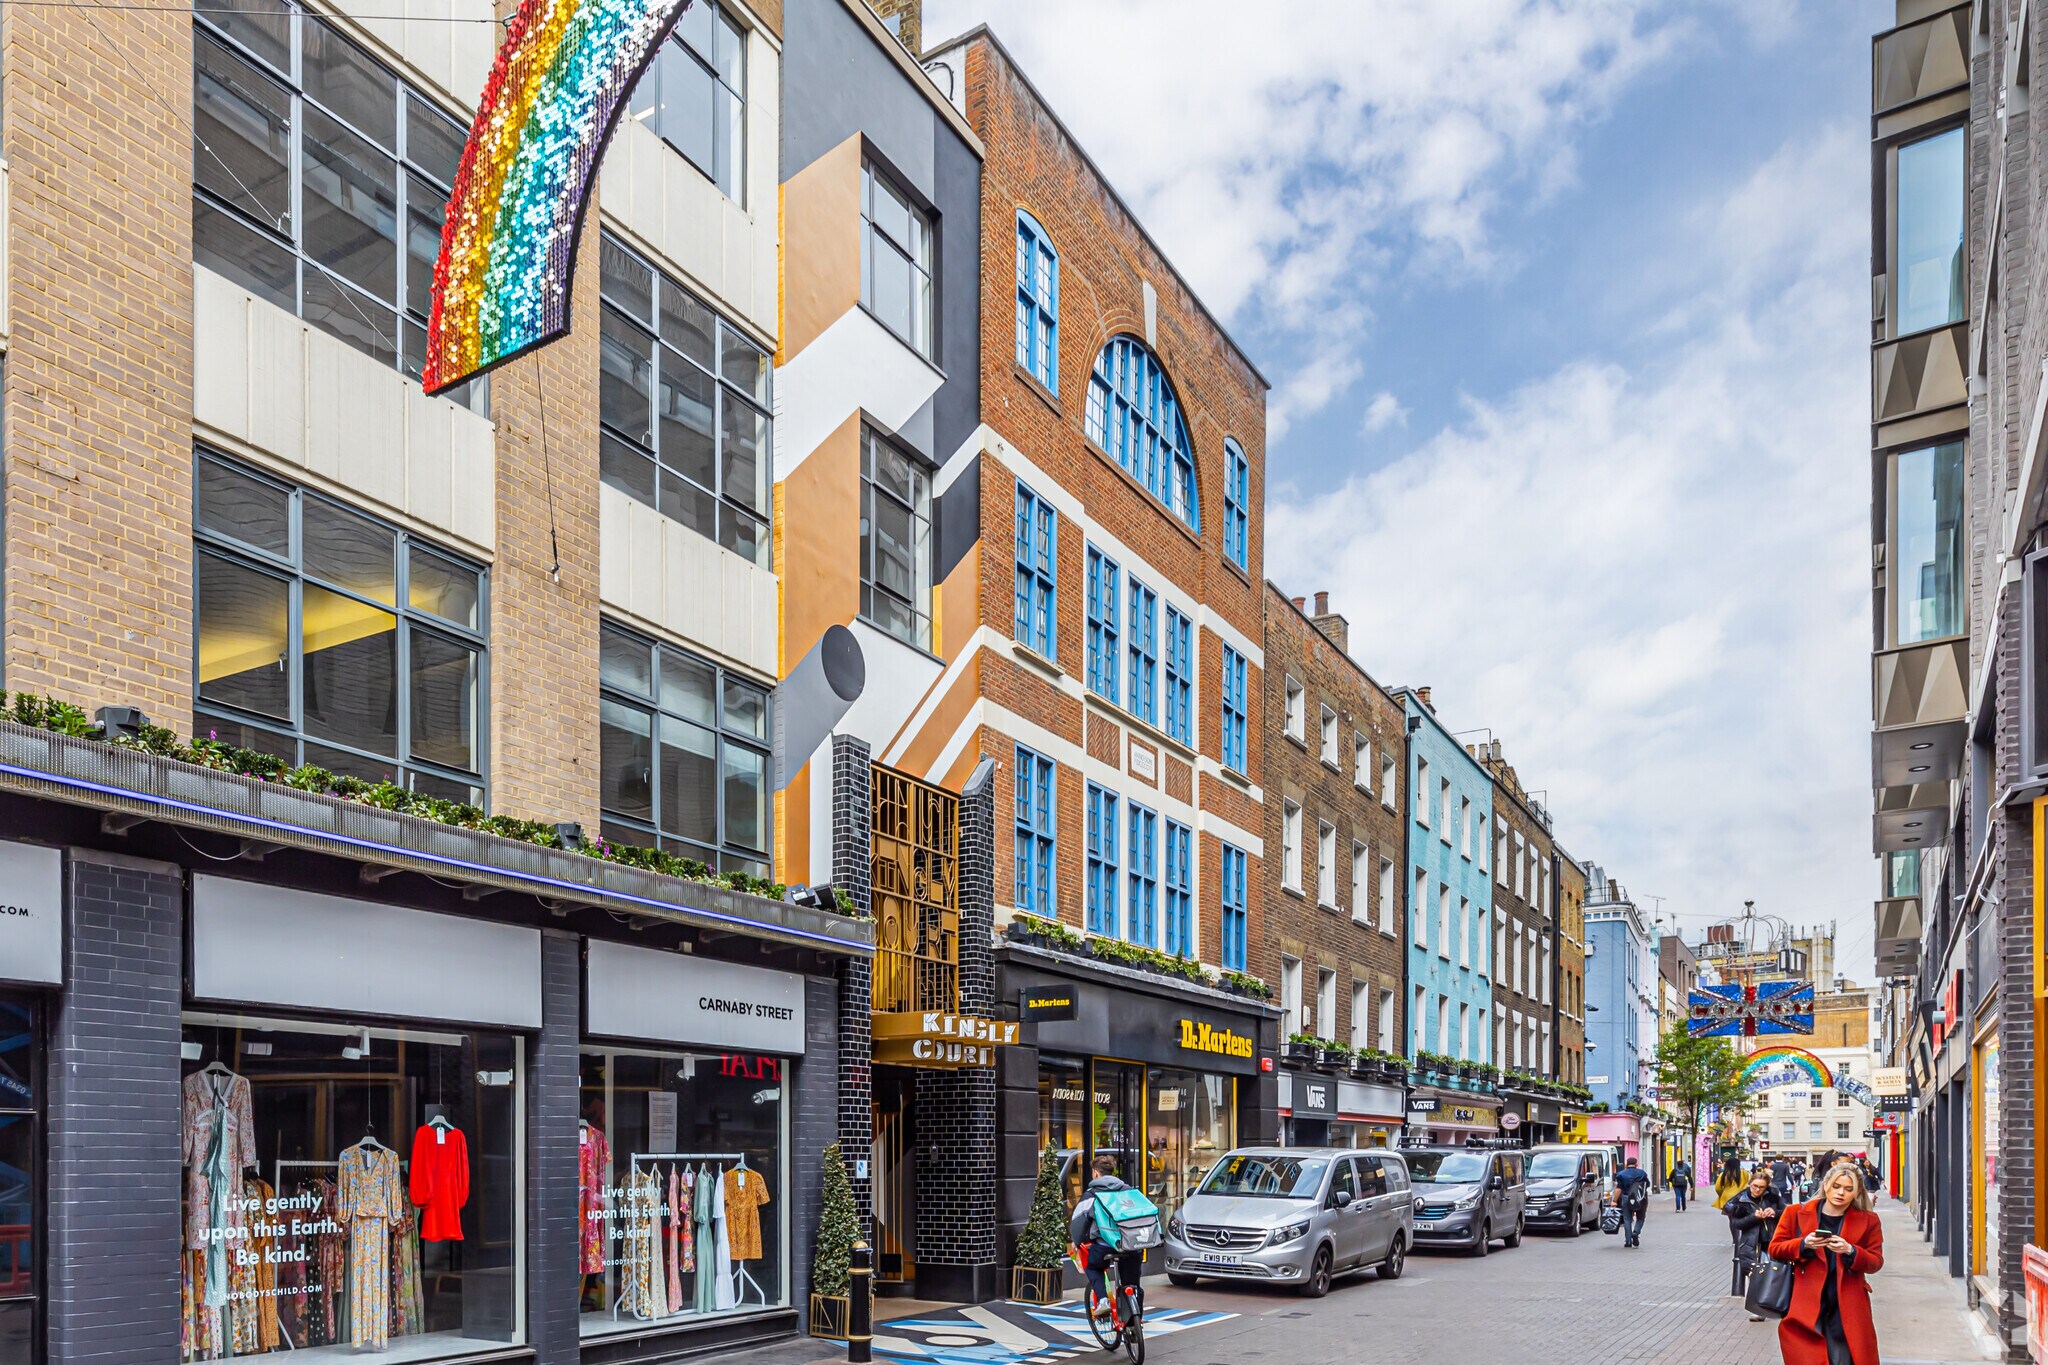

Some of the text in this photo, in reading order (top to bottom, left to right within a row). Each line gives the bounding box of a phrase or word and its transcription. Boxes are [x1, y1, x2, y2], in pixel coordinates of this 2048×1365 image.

[699, 997, 793, 1020] CARNABY STREET
[1691, 1000, 1814, 1019] CARNABY
[922, 1012, 1016, 1043] KINGLY
[912, 1039, 992, 1065] COURT
[1306, 1084, 1326, 1109] VANS
[1412, 1101, 1435, 1110] VANS
[601, 1185, 625, 1198] Live
[223, 1191, 323, 1215] Live gently
[587, 1208, 617, 1223] upon
[198, 1216, 343, 1245] upon this Earth.
[609, 1226, 624, 1239] Be
[236, 1244, 311, 1266] Be kind.
[1203, 1253, 1237, 1264] EW19 FKT
[223, 1284, 323, 1300] NOBODYSCHILD.COM
